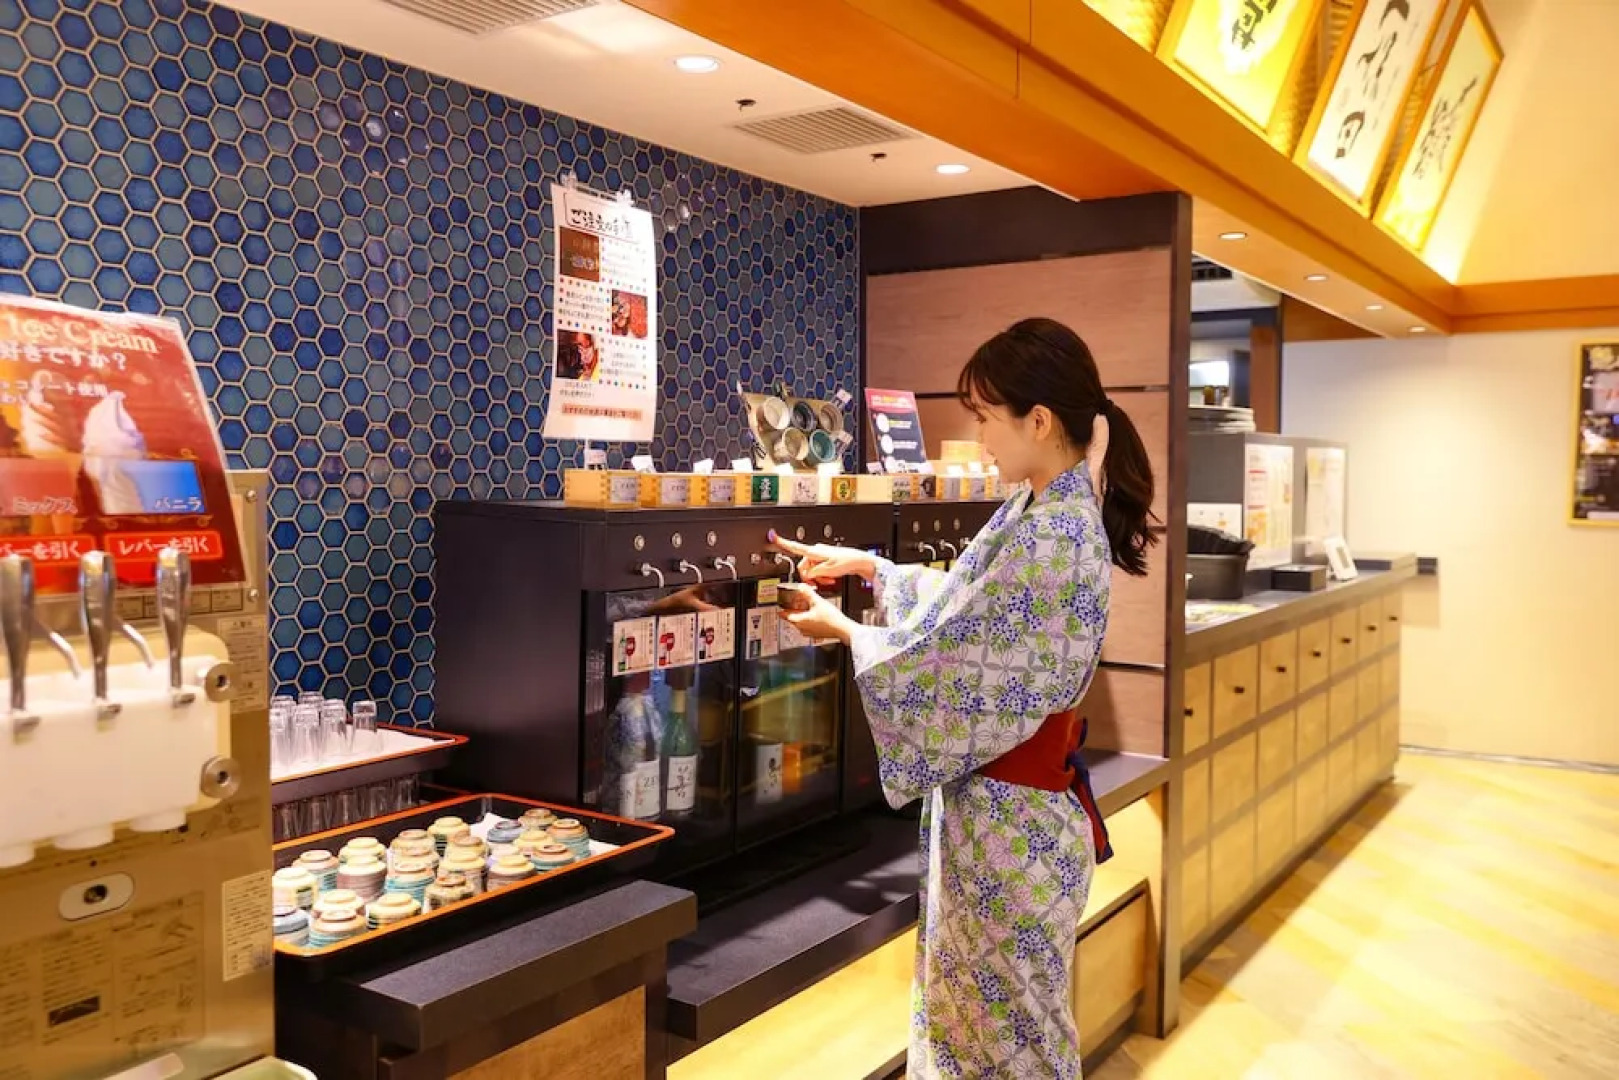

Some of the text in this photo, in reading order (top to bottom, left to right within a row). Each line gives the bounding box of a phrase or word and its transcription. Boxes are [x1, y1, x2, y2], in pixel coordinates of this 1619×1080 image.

[64, 320, 157, 354] Cream
[155, 496, 202, 511] バニラ
[119, 537, 209, 555] レバーを引く
